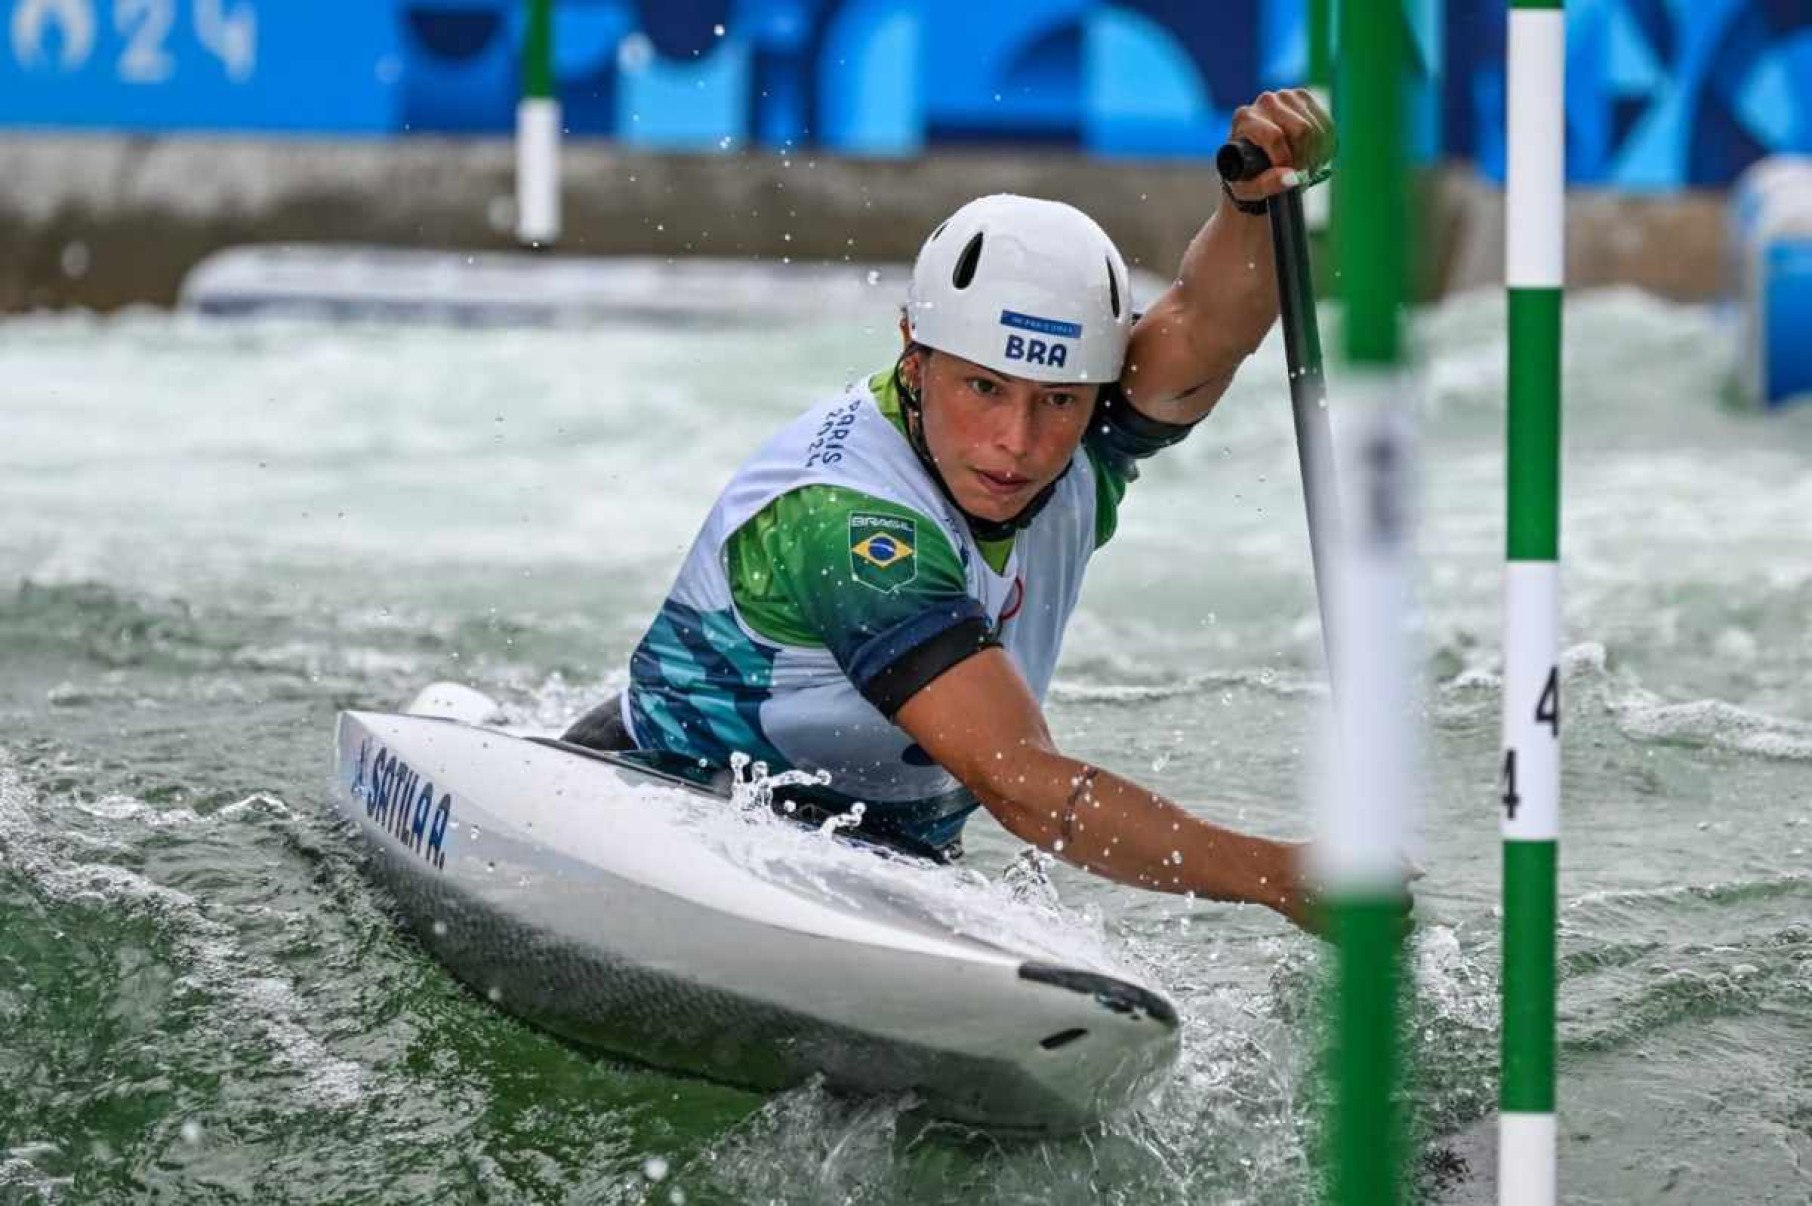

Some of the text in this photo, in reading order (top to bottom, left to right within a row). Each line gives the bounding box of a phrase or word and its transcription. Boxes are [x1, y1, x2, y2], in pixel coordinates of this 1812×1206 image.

[1005, 334, 1067, 368] BRA
[822, 399, 861, 465] PARIS
[851, 517, 914, 532] BRASIL
[1535, 664, 1559, 738] 4
[367, 747, 433, 855] SATILA
[1501, 748, 1521, 821] 4
